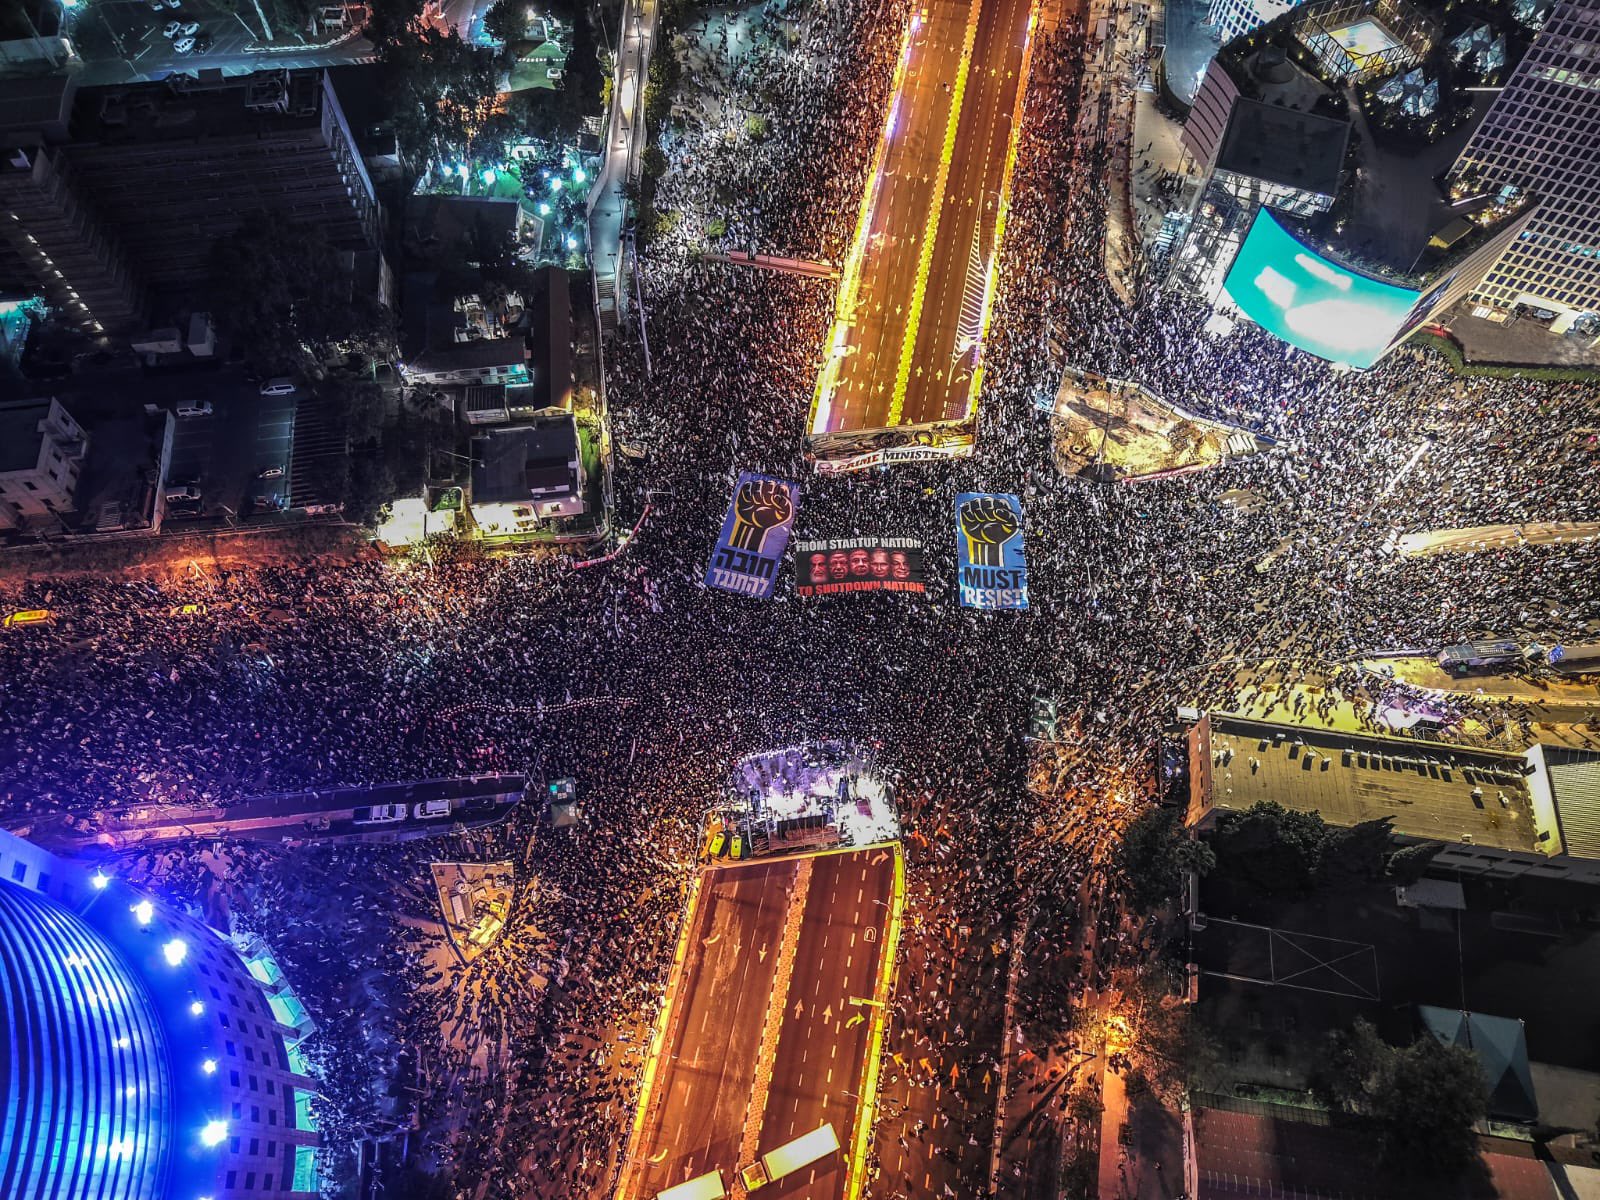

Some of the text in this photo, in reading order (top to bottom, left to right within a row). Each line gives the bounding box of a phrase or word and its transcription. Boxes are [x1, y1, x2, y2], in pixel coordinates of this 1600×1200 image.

[836, 450, 949, 471] CRIME MINISTER
[796, 537, 921, 552] FROM STARTUP NATION
[716, 548, 776, 579] חובה
[713, 567, 769, 596] להתנגד
[964, 566, 1021, 589] MUST
[799, 581, 926, 596] TO SHUTDOWN NATION
[964, 586, 1023, 606] RESIST
